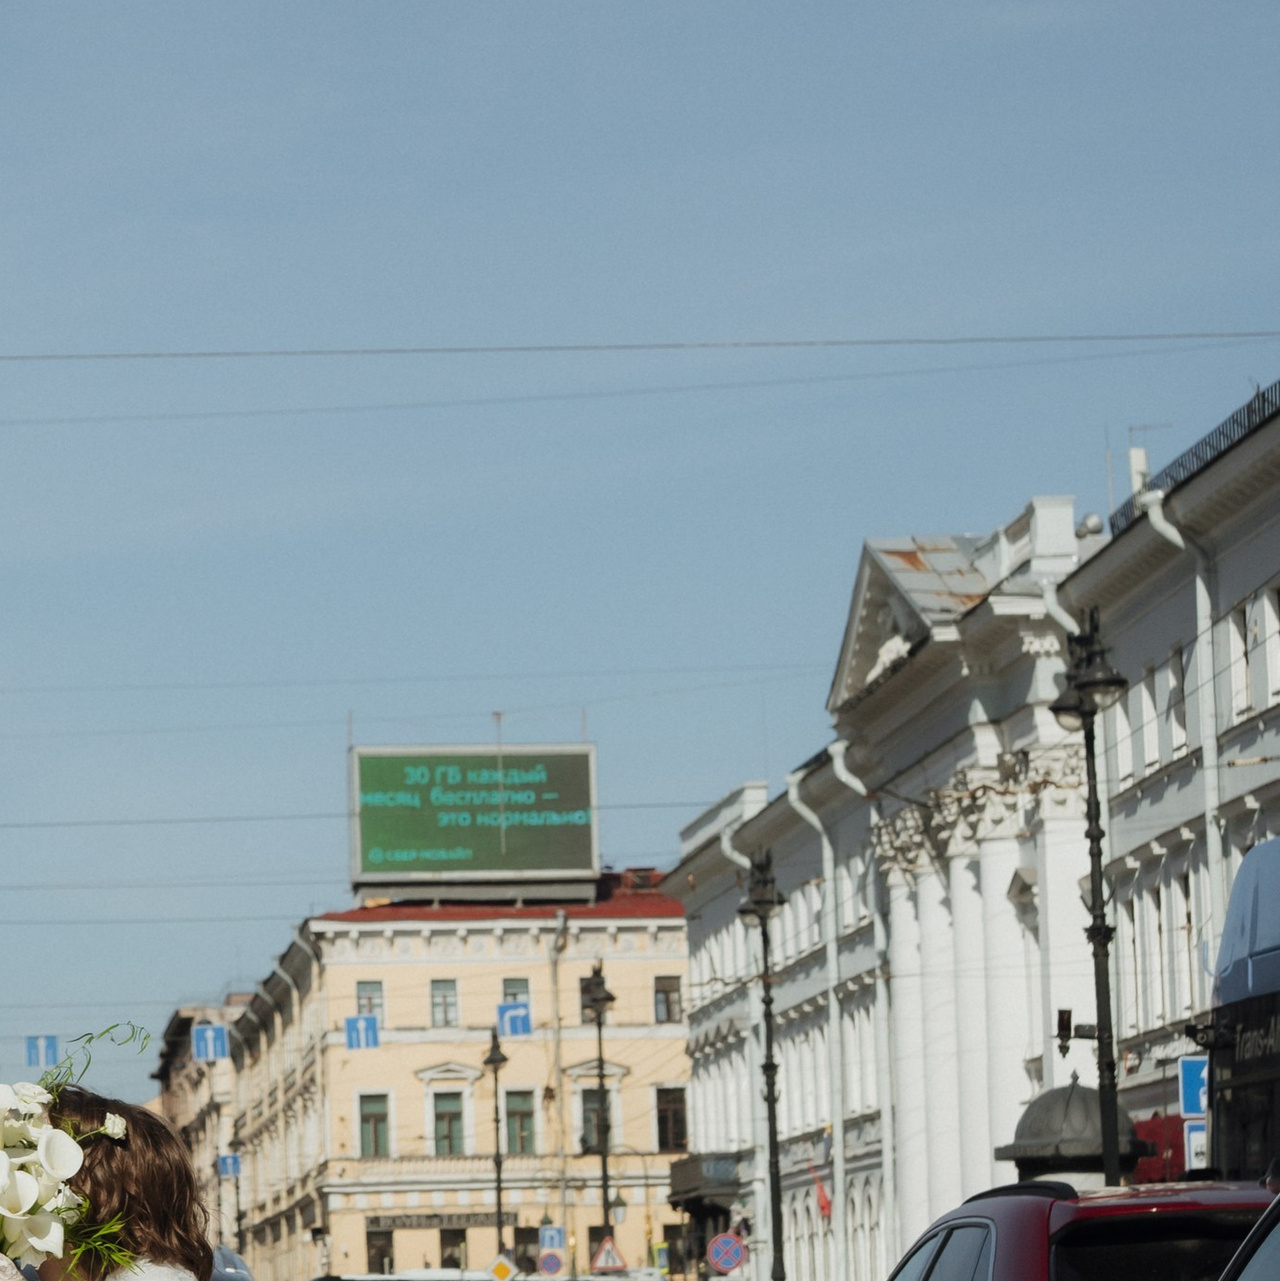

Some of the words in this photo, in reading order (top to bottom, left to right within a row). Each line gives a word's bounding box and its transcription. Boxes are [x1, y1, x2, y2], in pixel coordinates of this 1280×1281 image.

[403, 765, 430, 785] 30
[434, 765, 462, 785] ГБ
[467, 763, 548, 785] каждый
[429, 786, 536, 807] бесплатно
[436, 811, 472, 828] это
